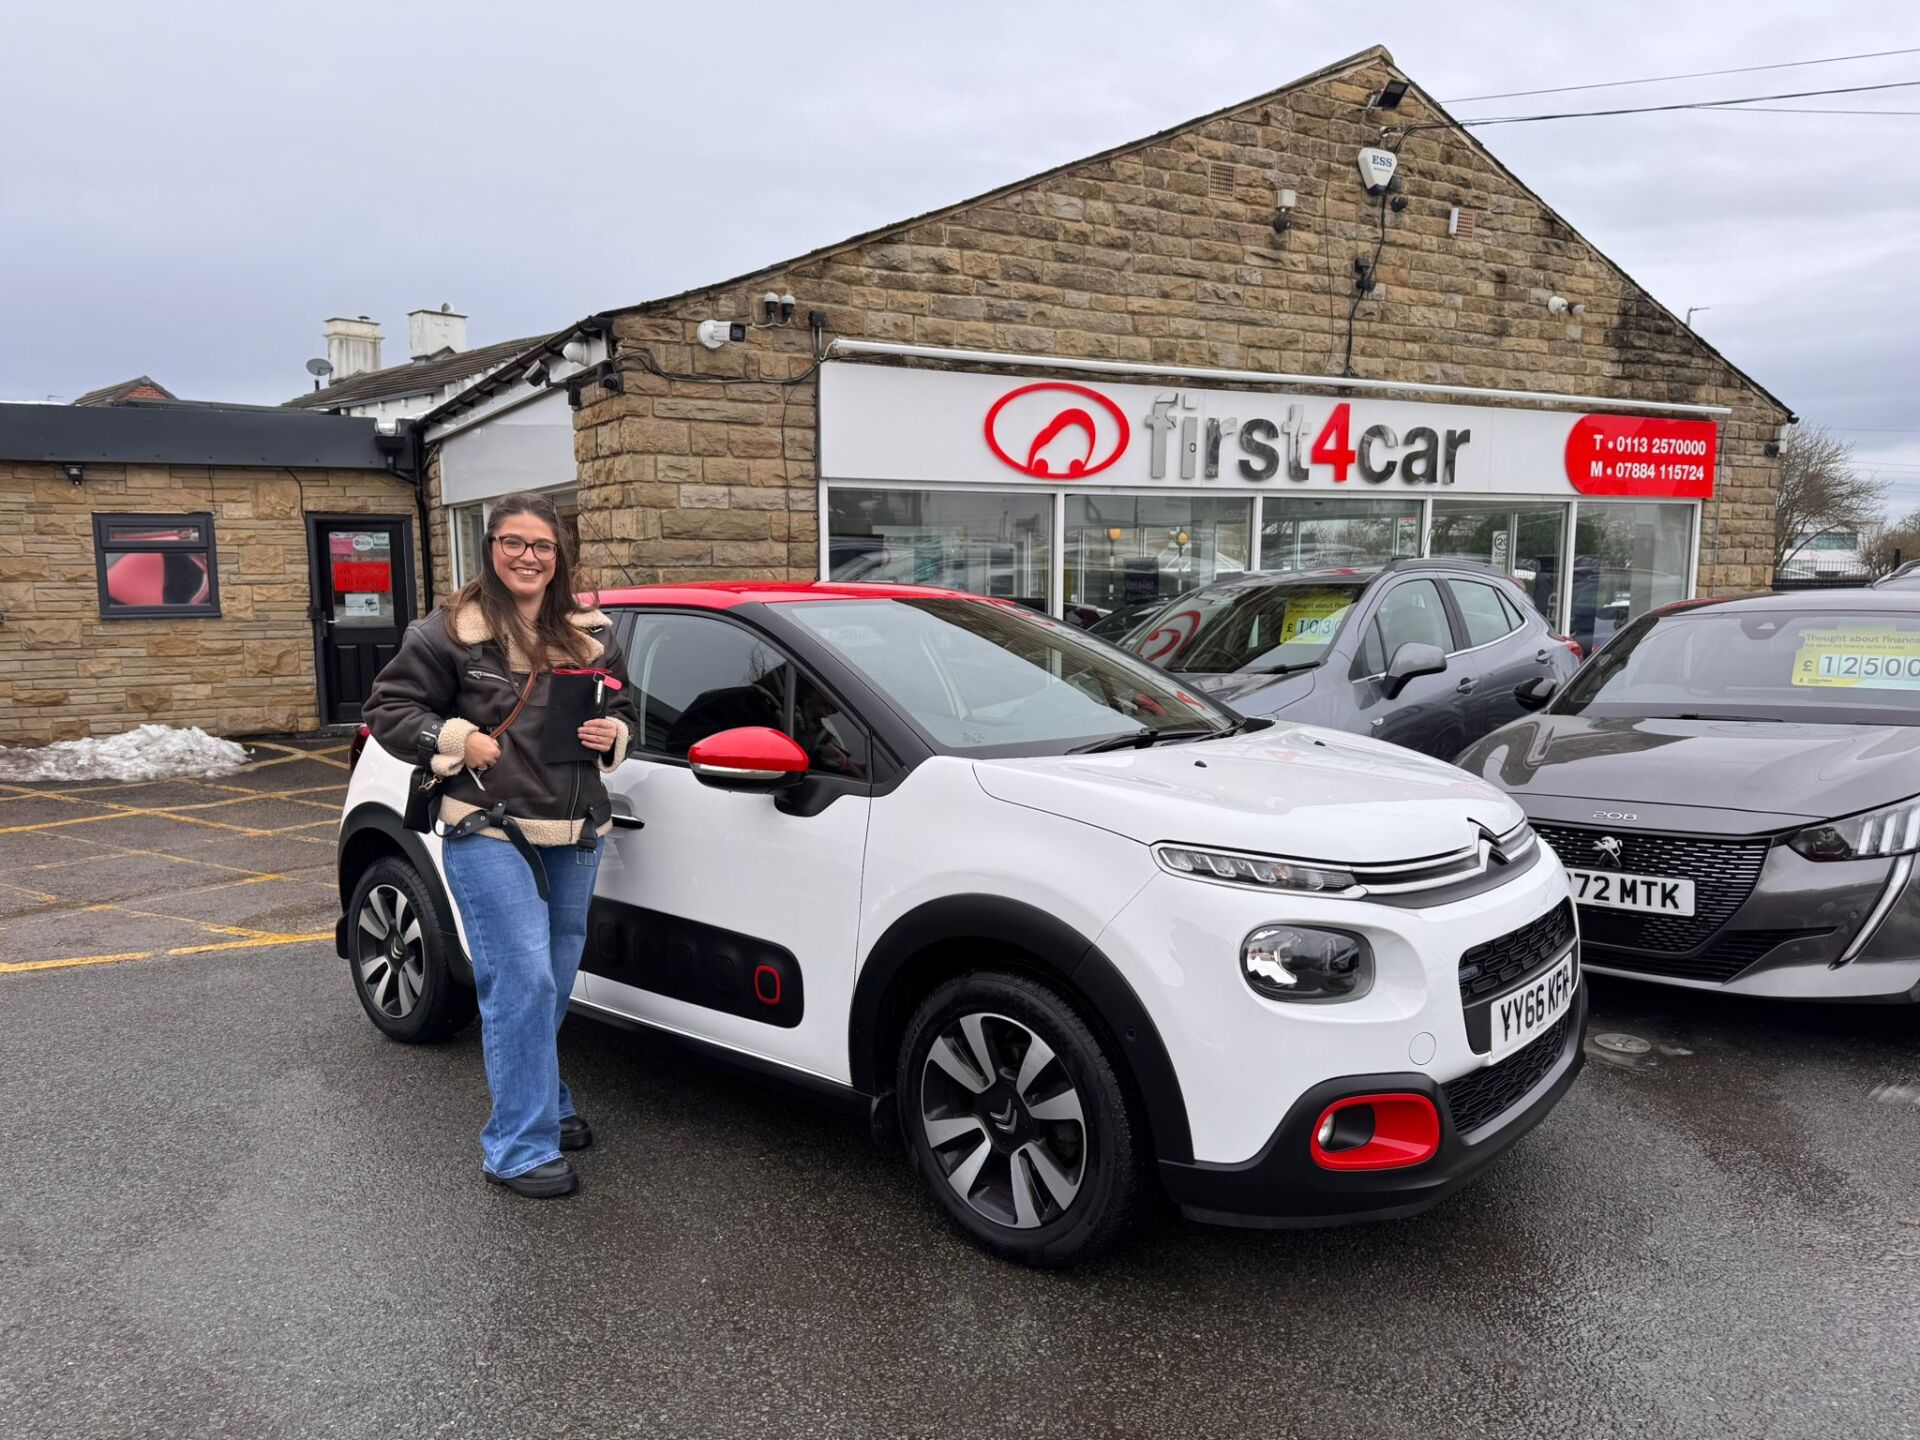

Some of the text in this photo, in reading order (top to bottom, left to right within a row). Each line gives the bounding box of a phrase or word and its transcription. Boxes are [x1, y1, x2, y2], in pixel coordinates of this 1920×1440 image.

[1372, 155, 1393, 168] ESS
[1593, 434, 1707, 456] T 0113 2570000
[1590, 461, 1705, 481] M 07884 115724
[1286, 622, 1294, 633] £
[1806, 633, 1846, 644] Thought
[1849, 634, 1878, 643] about
[1802, 656, 1920, 677] £ 12500
[1592, 811, 1638, 821] 208
[1619, 878, 1680, 909] MTK
[1500, 963, 1570, 1042] YY66 KFR
